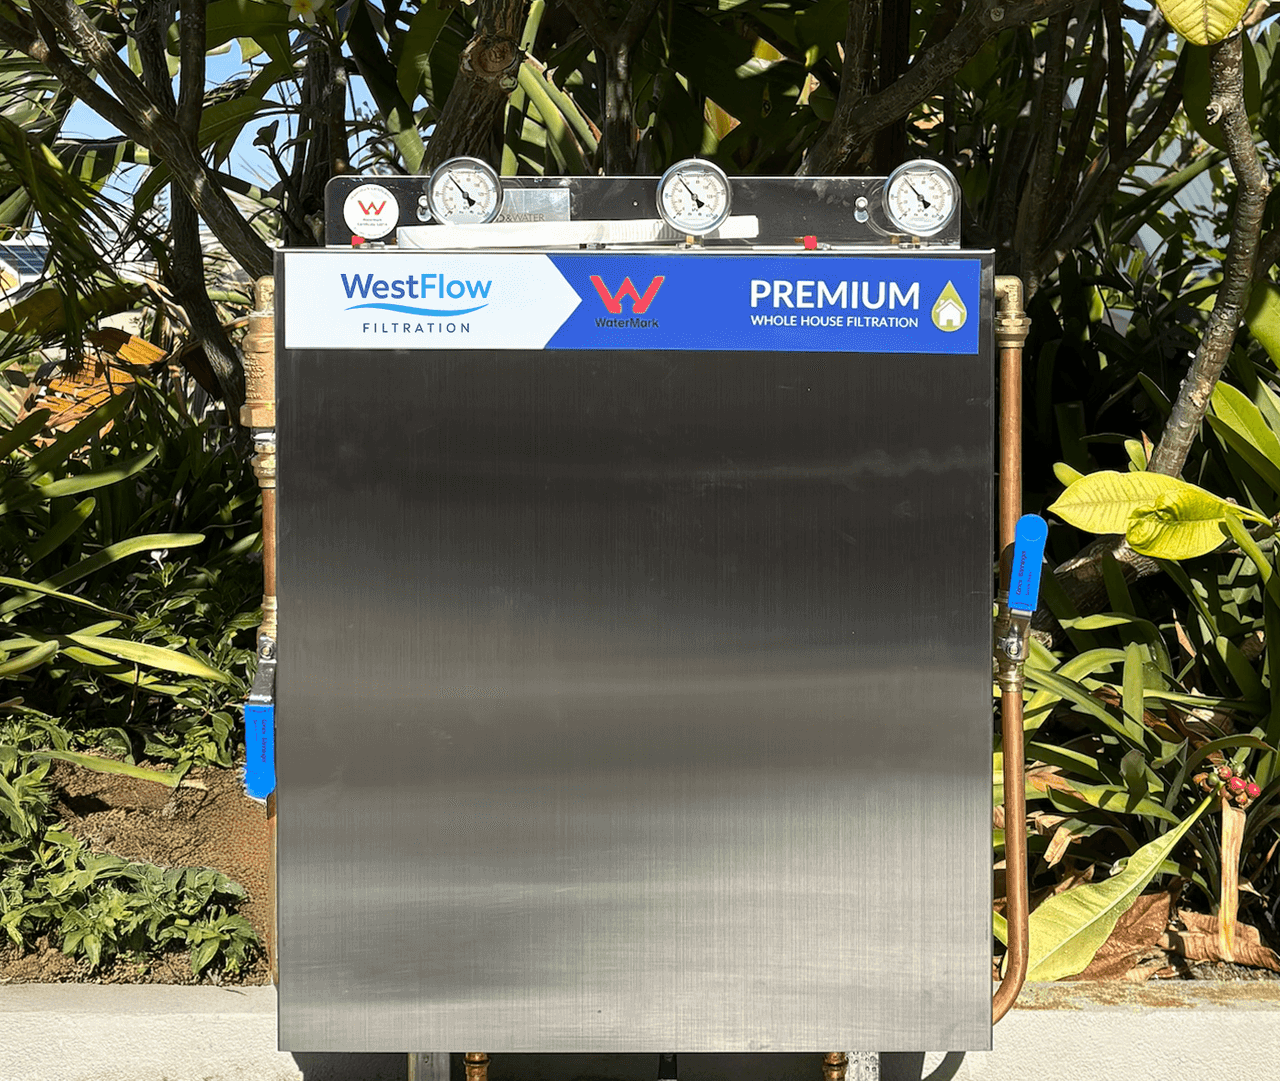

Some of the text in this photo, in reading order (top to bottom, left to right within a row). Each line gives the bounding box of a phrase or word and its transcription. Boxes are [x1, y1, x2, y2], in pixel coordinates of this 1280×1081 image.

[340, 273, 493, 299] WestFlow
[750, 279, 920, 310] PREMIUM
[362, 322, 470, 333] FILTRATION
[595, 317, 659, 328] WaterMark
[750, 315, 918, 328] WHOLE HOUSE FILTRATION
